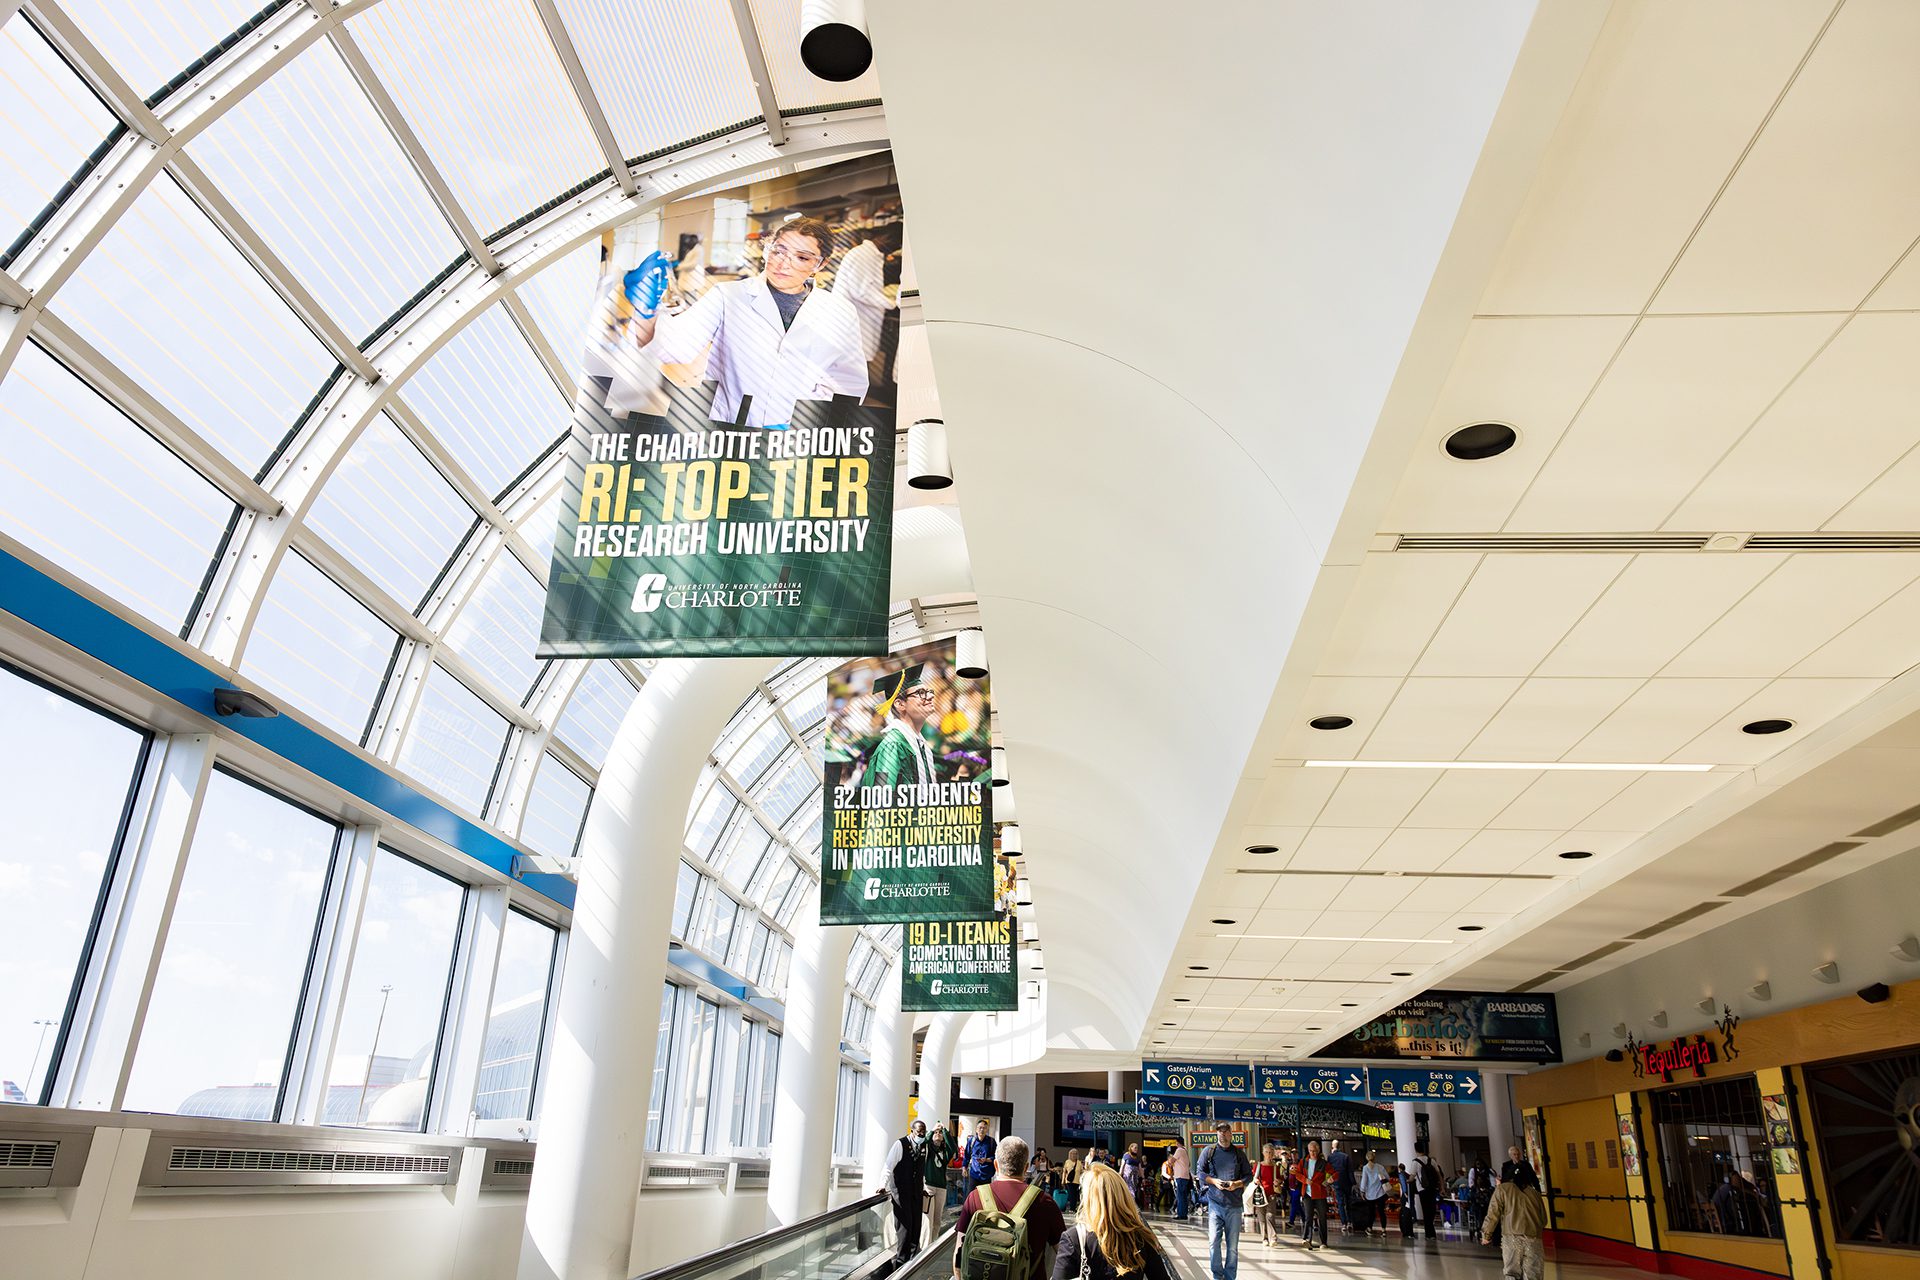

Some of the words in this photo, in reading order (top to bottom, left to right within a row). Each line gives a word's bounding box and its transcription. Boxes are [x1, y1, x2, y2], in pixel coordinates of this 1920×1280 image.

[590, 433, 629, 461] THE
[635, 429, 761, 461] CHARLOTTE
[768, 427, 874, 458] REGION'S
[660, 458, 870, 522] TOP-TIER
[573, 523, 709, 557] RESEARCH
[717, 518, 870, 555] UNIVERSITY
[668, 583, 716, 591] UNIVERSITY
[665, 590, 801, 608] CHARLOTTE
[833, 785, 893, 809] 32,000
[897, 781, 982, 808] STUDENTS
[834, 810, 857, 829] THE
[861, 806, 982, 828] FASTEST-GROWING
[832, 829, 901, 848] RESEARCH
[905, 825, 982, 846] UNIVERSITY
[832, 848, 848, 870] IN
[853, 847, 902, 870] NORTH
[907, 844, 983, 868] CAROLINA
[881, 887, 950, 898] CHARLOTTE
[956, 922, 1011, 945] TEAMS
[909, 945, 972, 961] COMPETING
[976, 945, 986, 960] IN
[990, 944, 1011, 961] THE
[909, 961, 954, 974] AMERICAN
[956, 960, 1011, 974] CONFERENCE
[1413, 1000, 1444, 1010] looking
[1487, 1003, 1545, 1013] BARBADOS
[1436, 1040, 1447, 1052] is
[1449, 1041, 1462, 1056] it!
[1639, 1034, 1711, 1083] Tequileria
[1167, 1065, 1212, 1073] Gates/Atrium
[1261, 1068, 1289, 1076] Elevator
[1318, 1069, 1338, 1077] Gates
[1429, 1072, 1443, 1080] Exit
[1445, 1072, 1454, 1080] to
[1193, 1135, 1218, 1143] CATAWB
